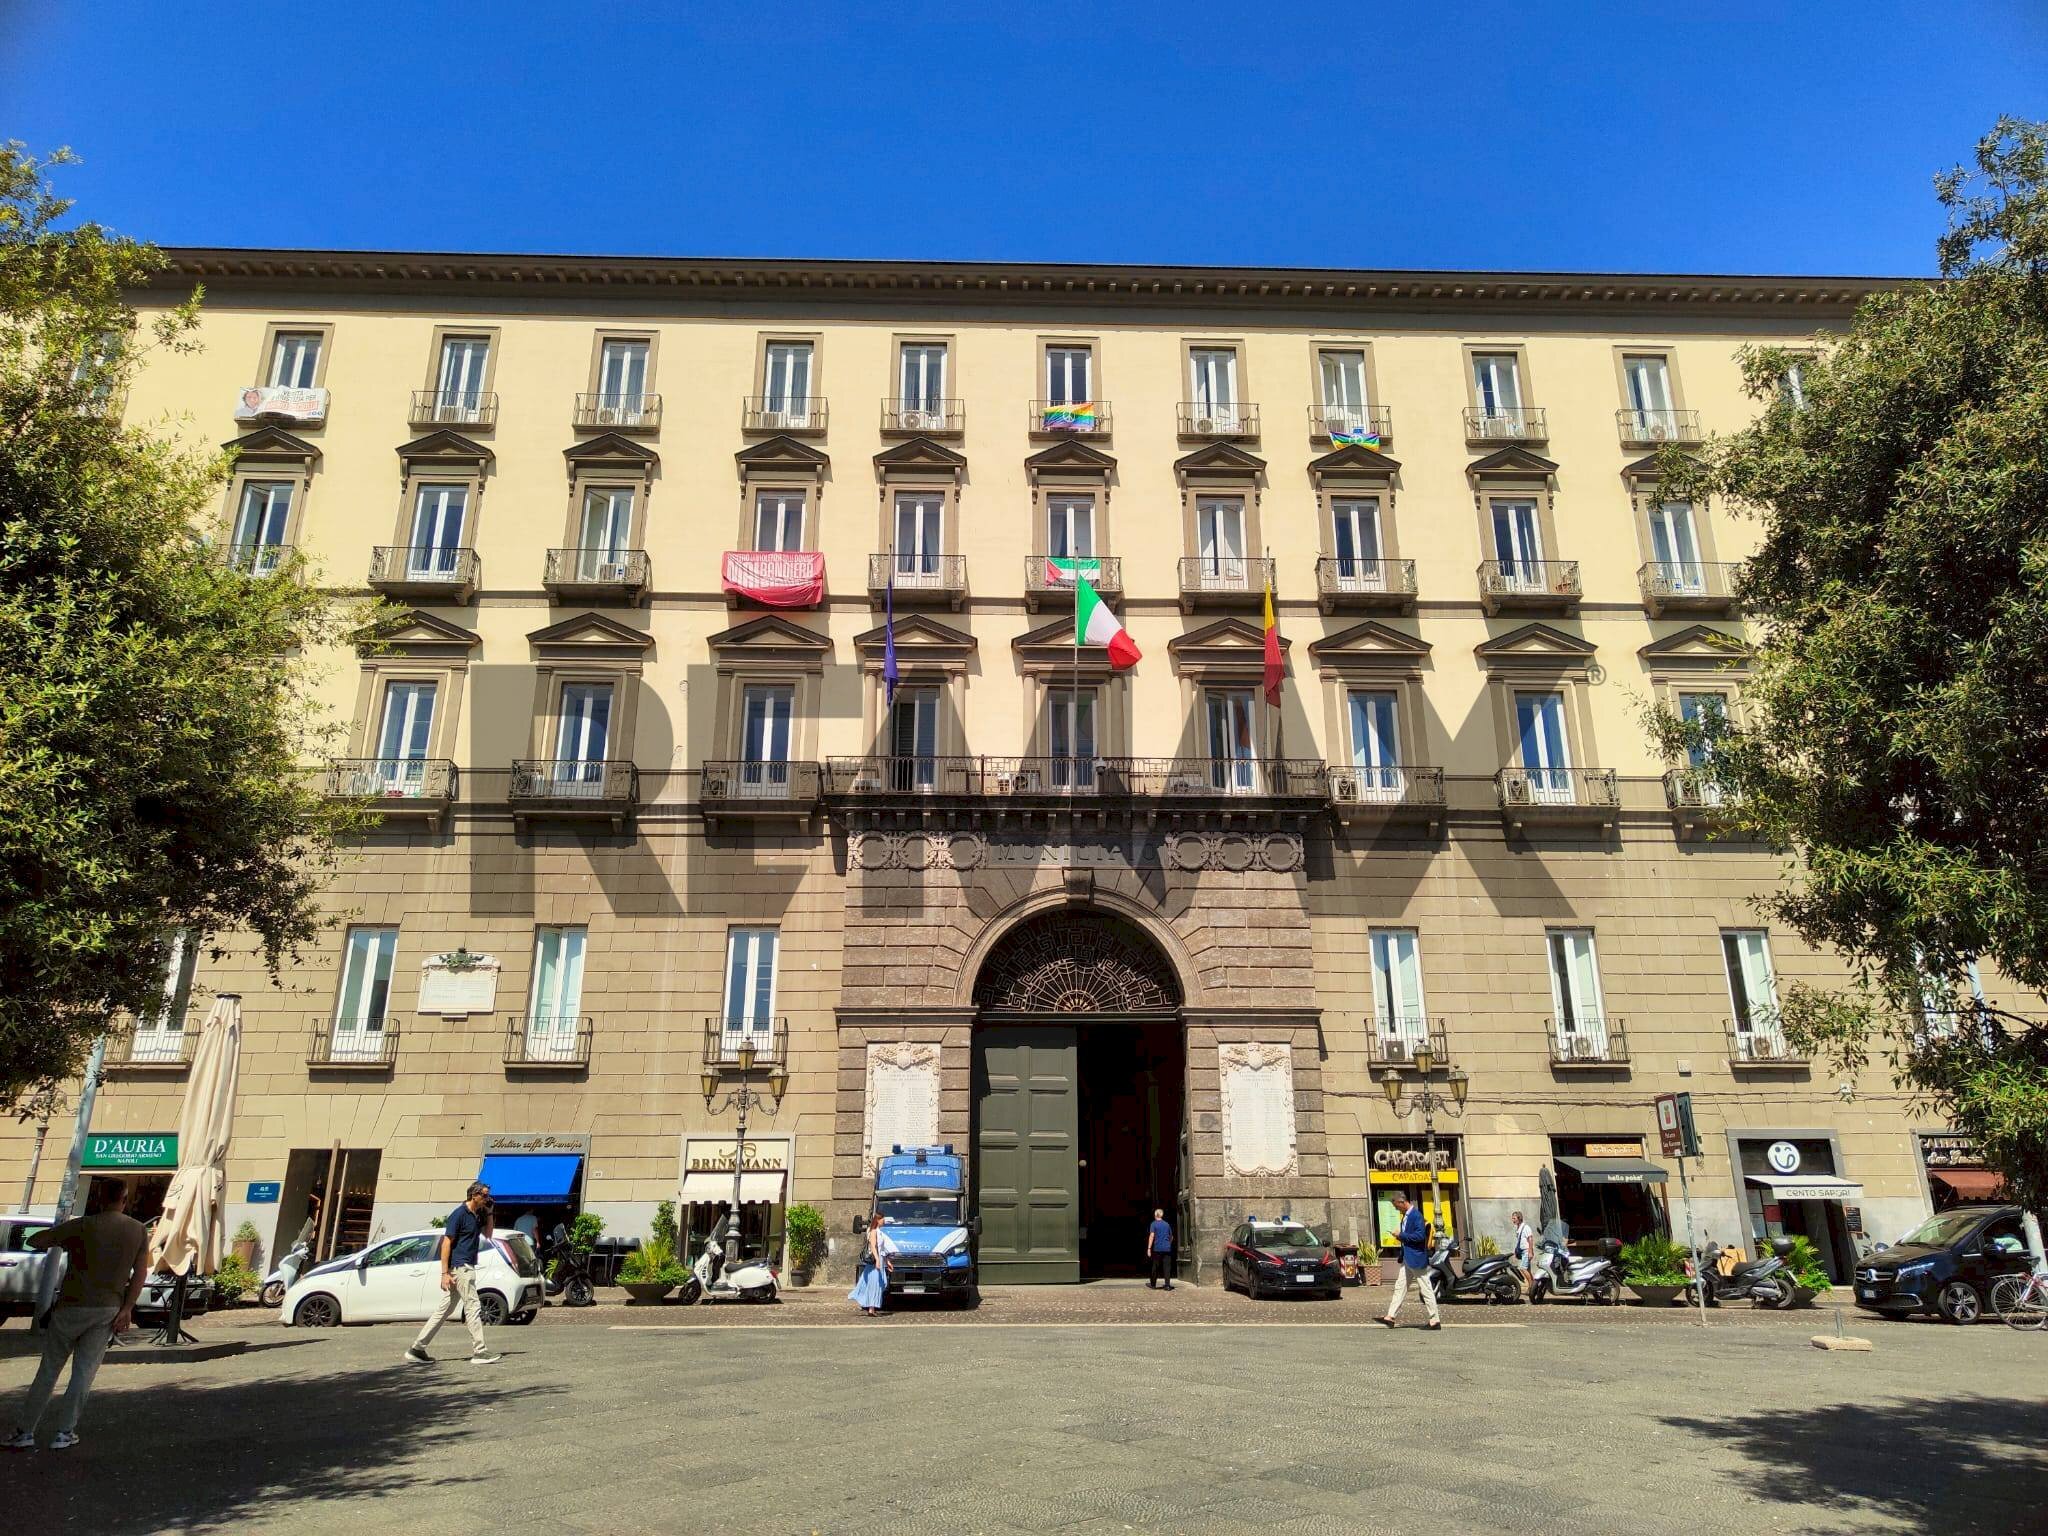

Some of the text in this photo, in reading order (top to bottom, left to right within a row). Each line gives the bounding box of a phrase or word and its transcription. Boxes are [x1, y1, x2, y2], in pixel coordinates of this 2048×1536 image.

[760, 561, 813, 578] BANDIERA
[997, 842, 1157, 861] MUNICIPIO
[93, 1139, 166, 1153] D'AURIA
[692, 1158, 782, 1170] BRINKMANN
[893, 1169, 948, 1177] POLIZIA
[1392, 1173, 1433, 1182] CAPATOA
